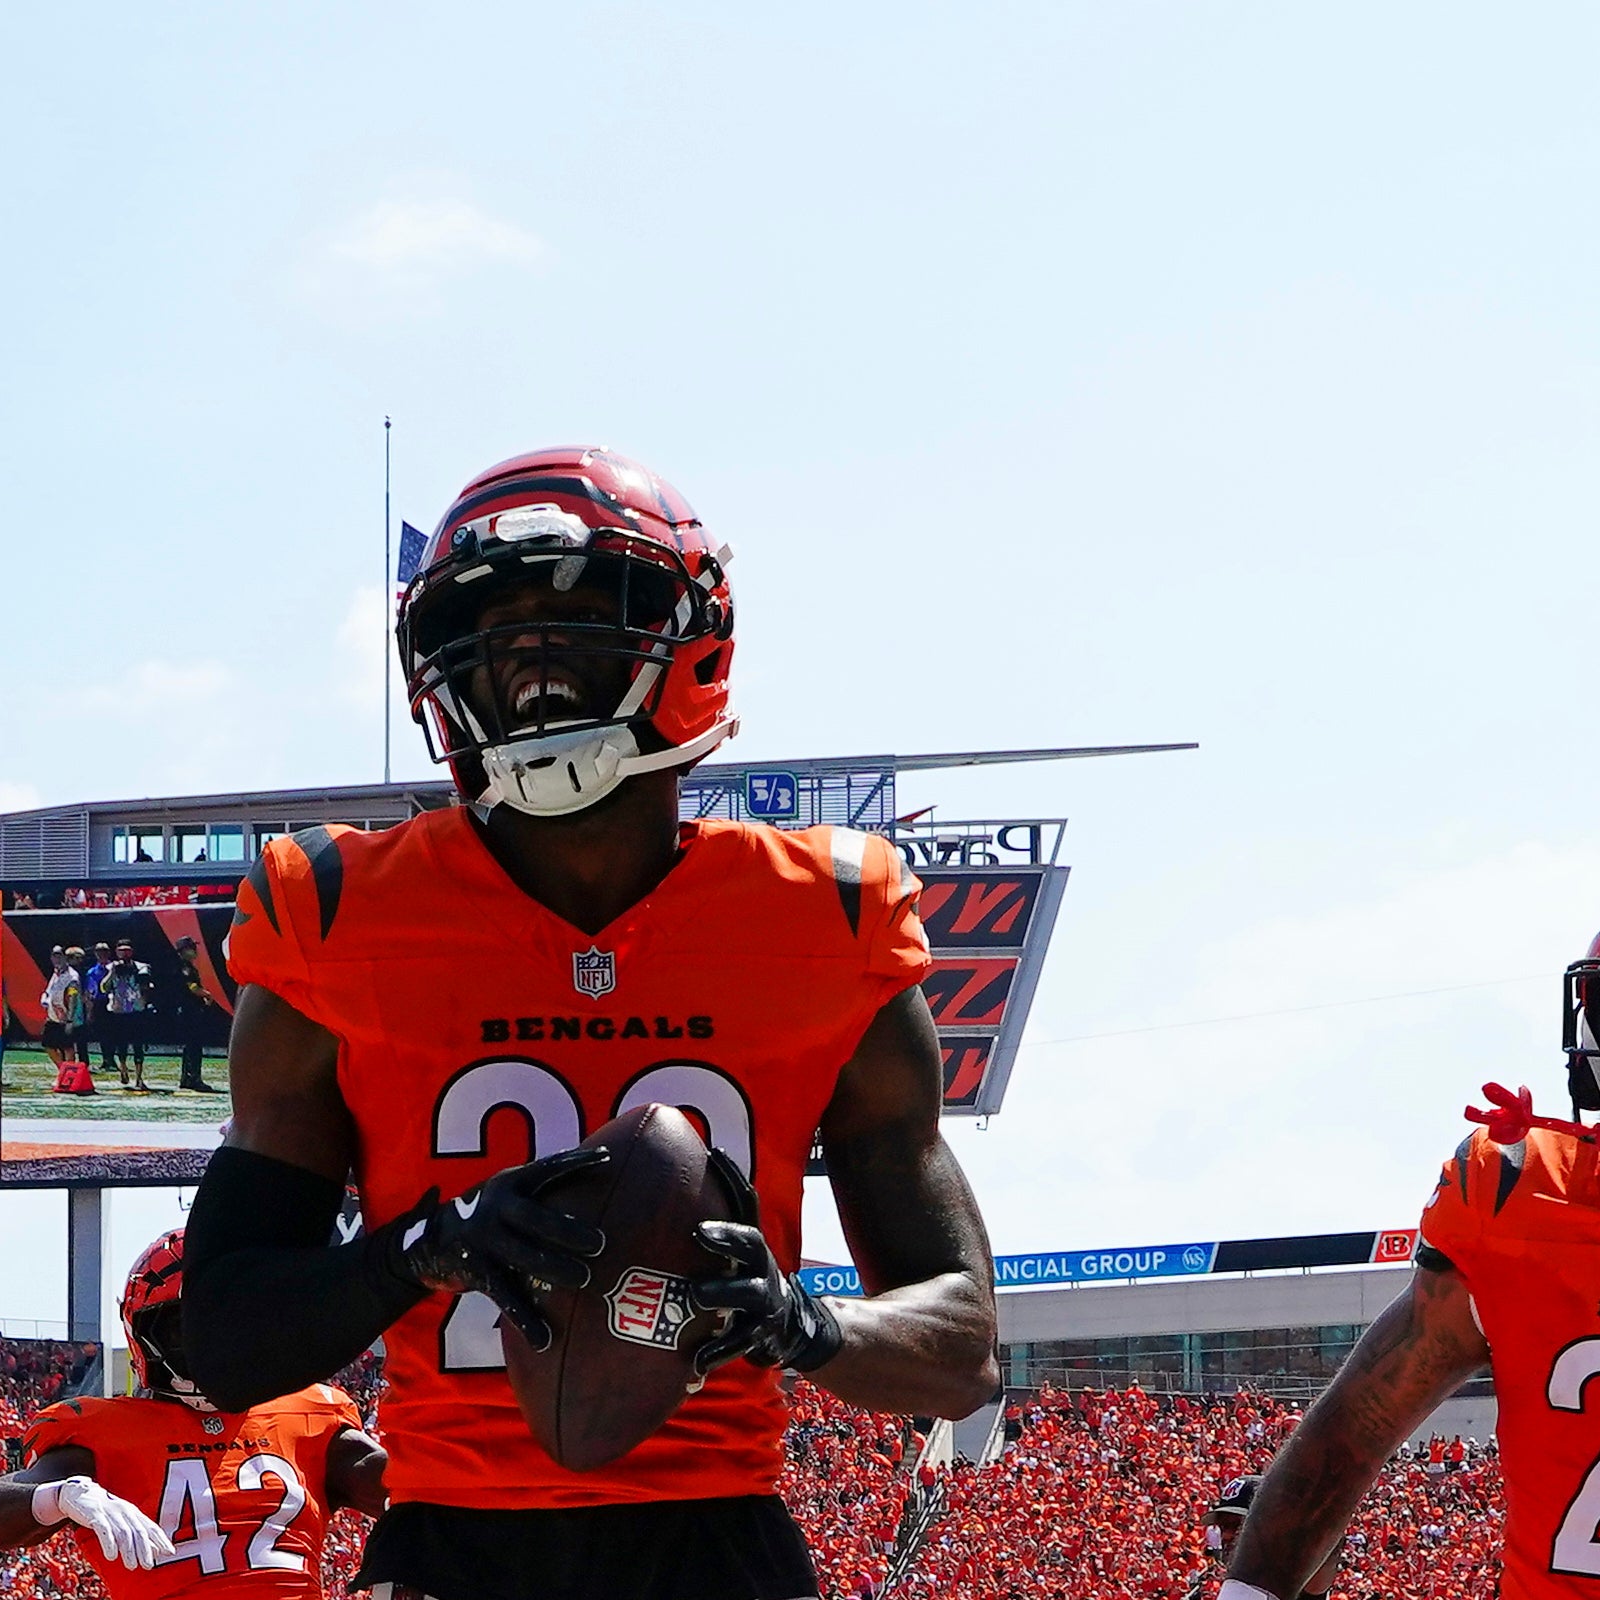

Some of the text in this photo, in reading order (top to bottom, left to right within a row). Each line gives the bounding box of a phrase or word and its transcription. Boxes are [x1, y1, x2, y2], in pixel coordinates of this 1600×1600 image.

[581, 968, 610, 989] NFL
[480, 1015, 716, 1044] BENGALS
[813, 1271, 860, 1292] SOU
[992, 1255, 1073, 1281] ANCIAL
[1081, 1251, 1167, 1275] GROUP
[617, 1275, 665, 1331] NFL
[167, 1437, 271, 1453] BENGALS
[152, 1452, 306, 1577] 42
